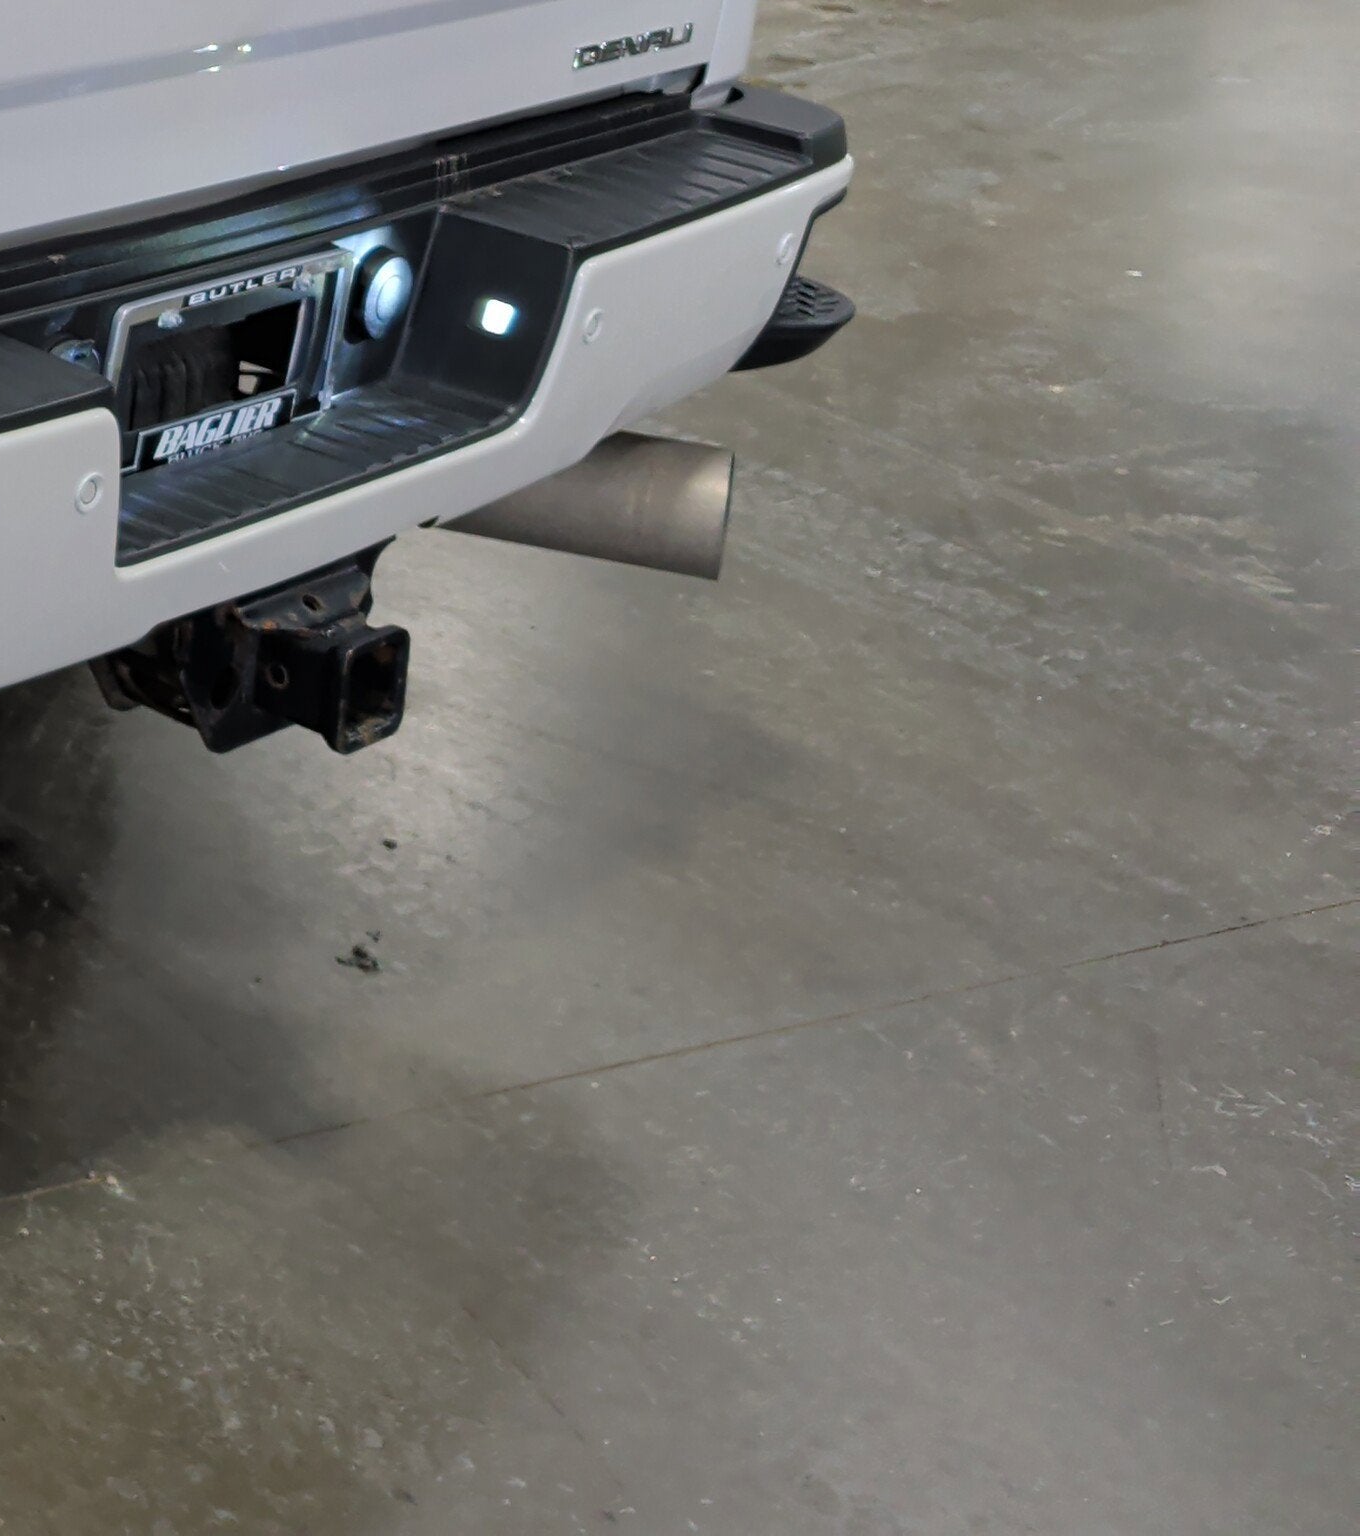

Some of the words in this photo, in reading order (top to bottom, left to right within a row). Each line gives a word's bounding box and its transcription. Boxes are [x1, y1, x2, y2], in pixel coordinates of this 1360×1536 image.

[573, 22, 693, 70] DENALI
[187, 265, 298, 305] BUTLER
[153, 397, 282, 461] BAGLIER
